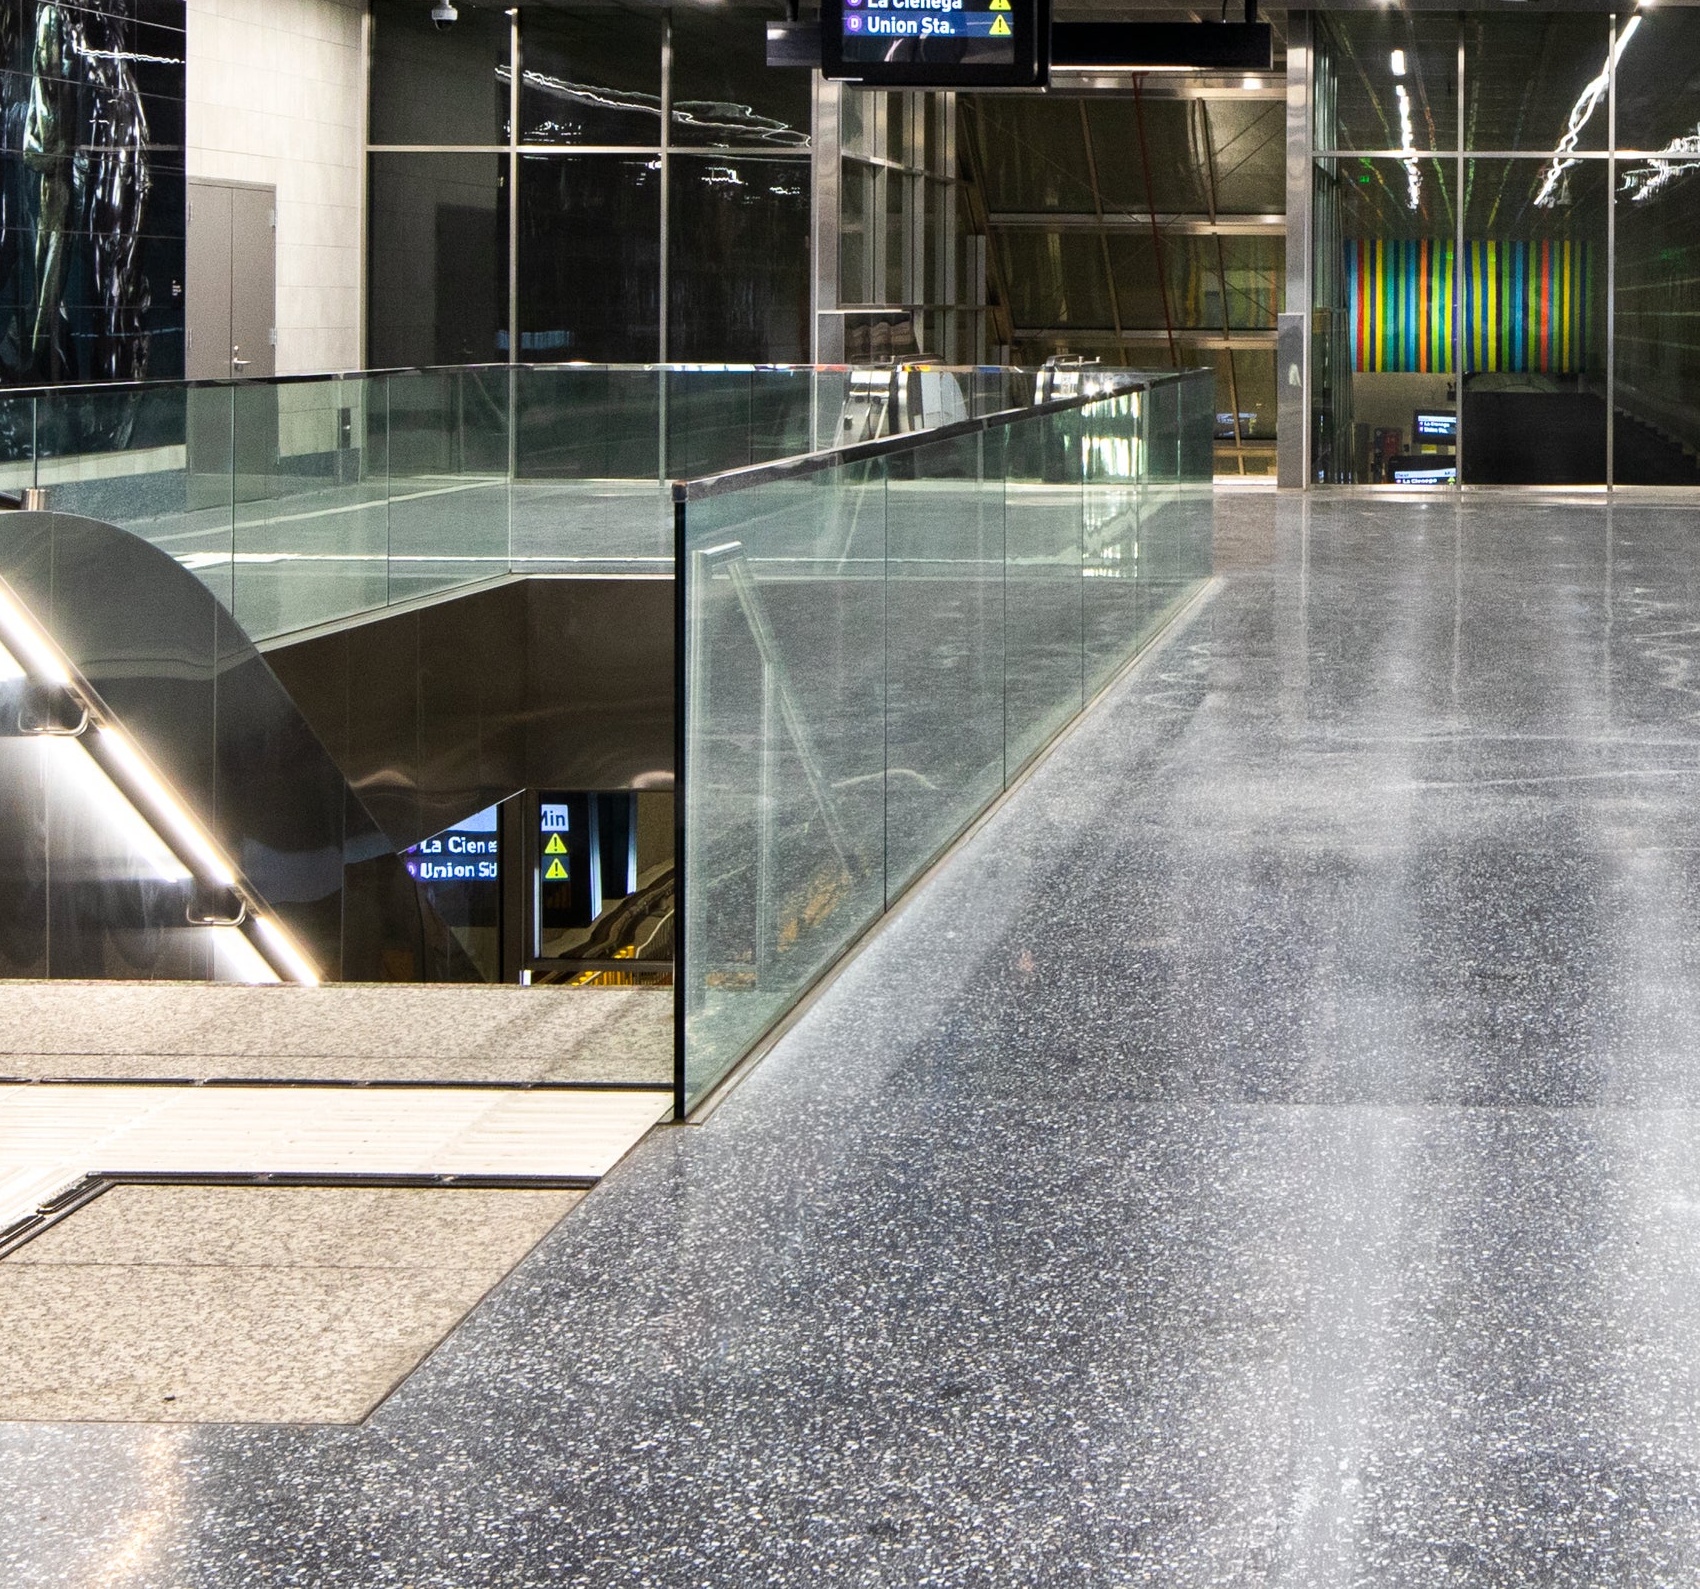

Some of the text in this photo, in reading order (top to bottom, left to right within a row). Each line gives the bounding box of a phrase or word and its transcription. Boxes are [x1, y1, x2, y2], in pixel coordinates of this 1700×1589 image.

[850, 16, 955, 34] D Union Sta.
